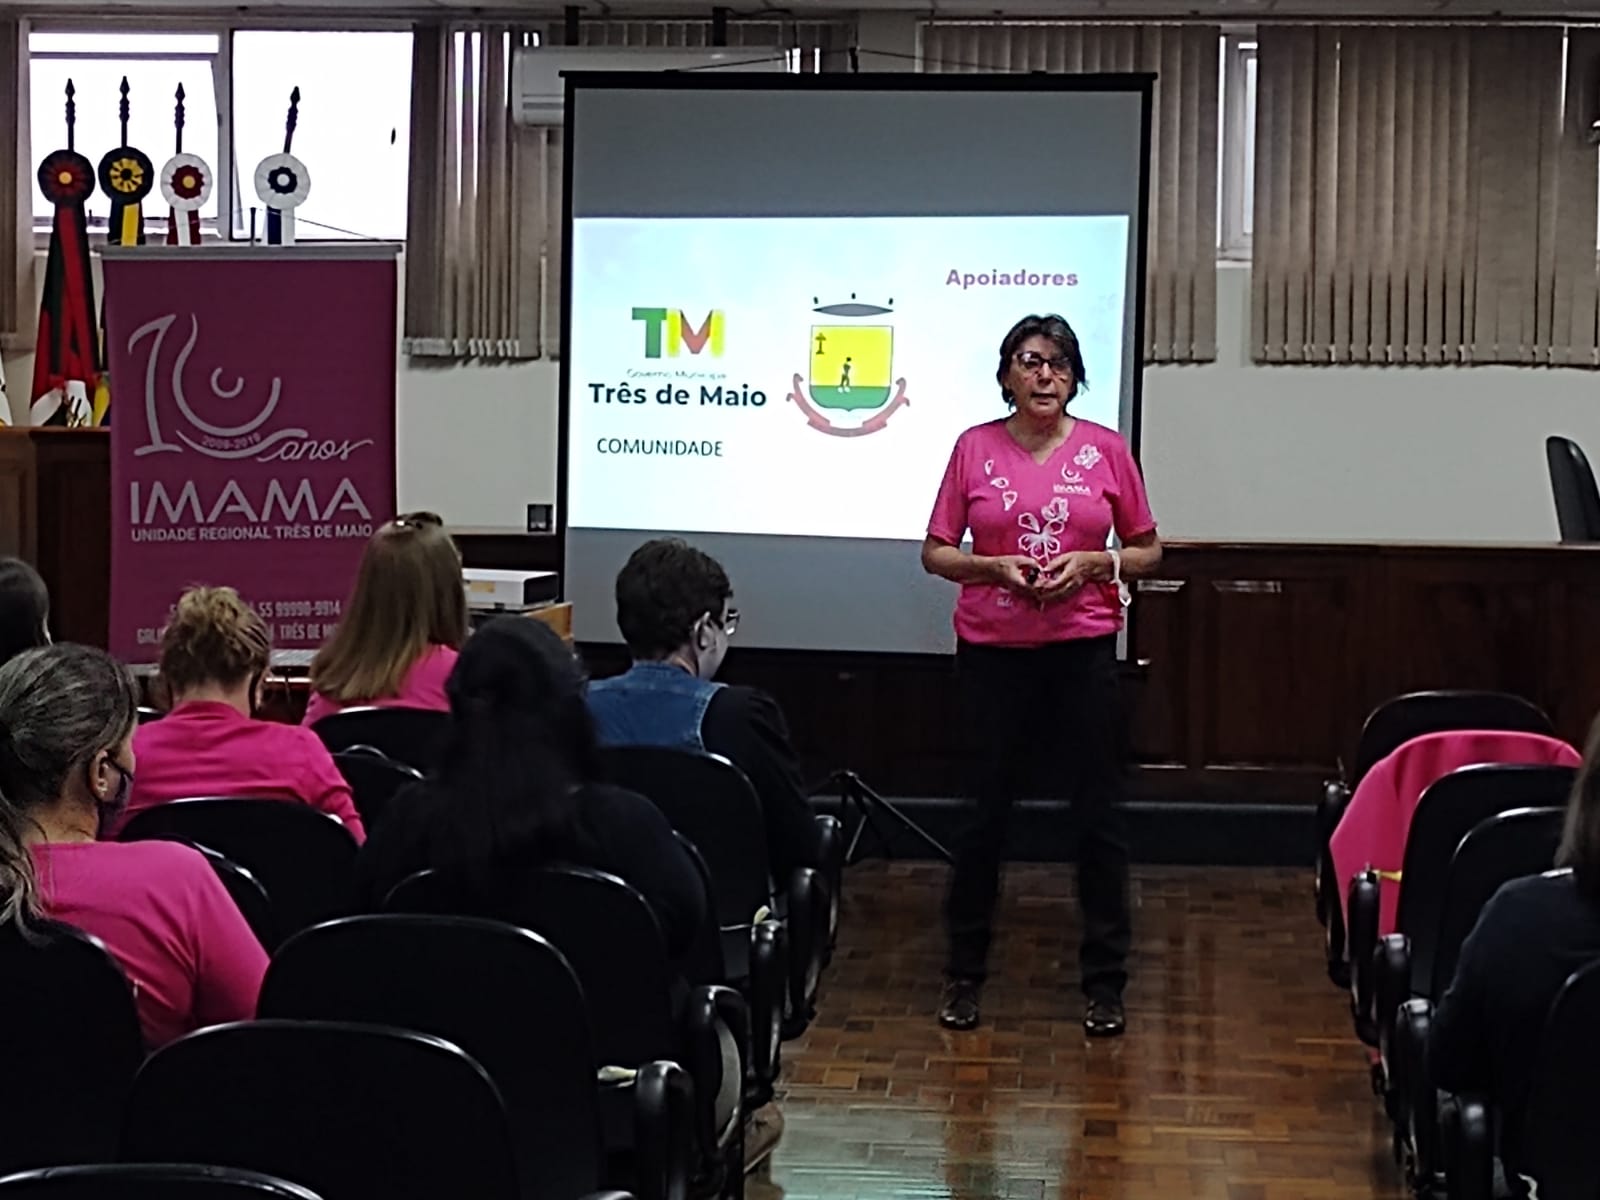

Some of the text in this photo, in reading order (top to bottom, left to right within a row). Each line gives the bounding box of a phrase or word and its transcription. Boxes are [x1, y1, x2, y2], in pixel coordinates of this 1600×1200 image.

[945, 269, 1079, 290] Apoiadores
[588, 382, 767, 407] Três de Maio
[257, 439, 374, 463] anos
[596, 438, 723, 456] COMUNIDADE
[130, 477, 373, 525] IMAMA
[131, 523, 374, 542] UNIDADE REGIONAL TRÊS DE MAIO
